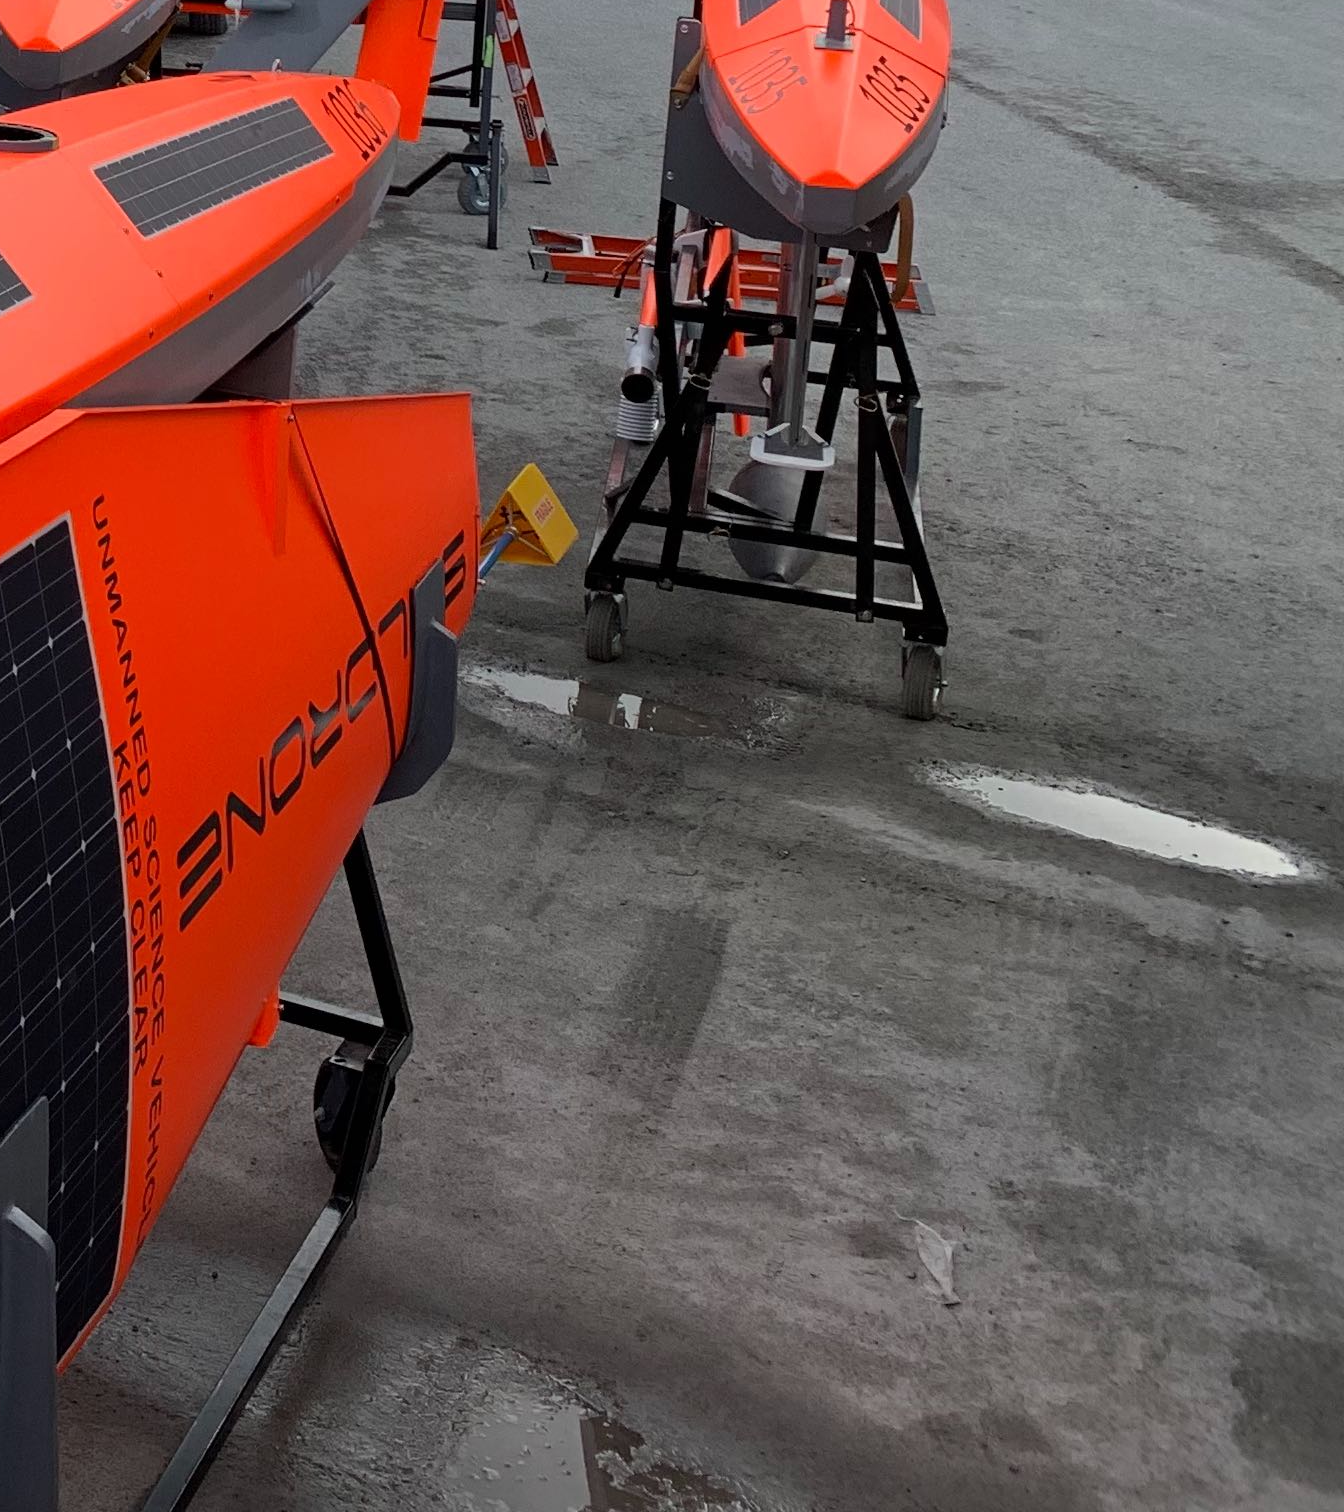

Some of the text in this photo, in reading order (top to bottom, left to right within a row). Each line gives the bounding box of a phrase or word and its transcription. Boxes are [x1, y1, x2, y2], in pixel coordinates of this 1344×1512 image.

[321, 79, 388, 161] 1036
[728, 48, 808, 115] 1035
[859, 56, 931, 133] 1035
[91, 494, 151, 797] UNMANNED
[143, 815, 165, 1046] SCIENCE
[112, 741, 149, 1077] KEEP CLEAR
